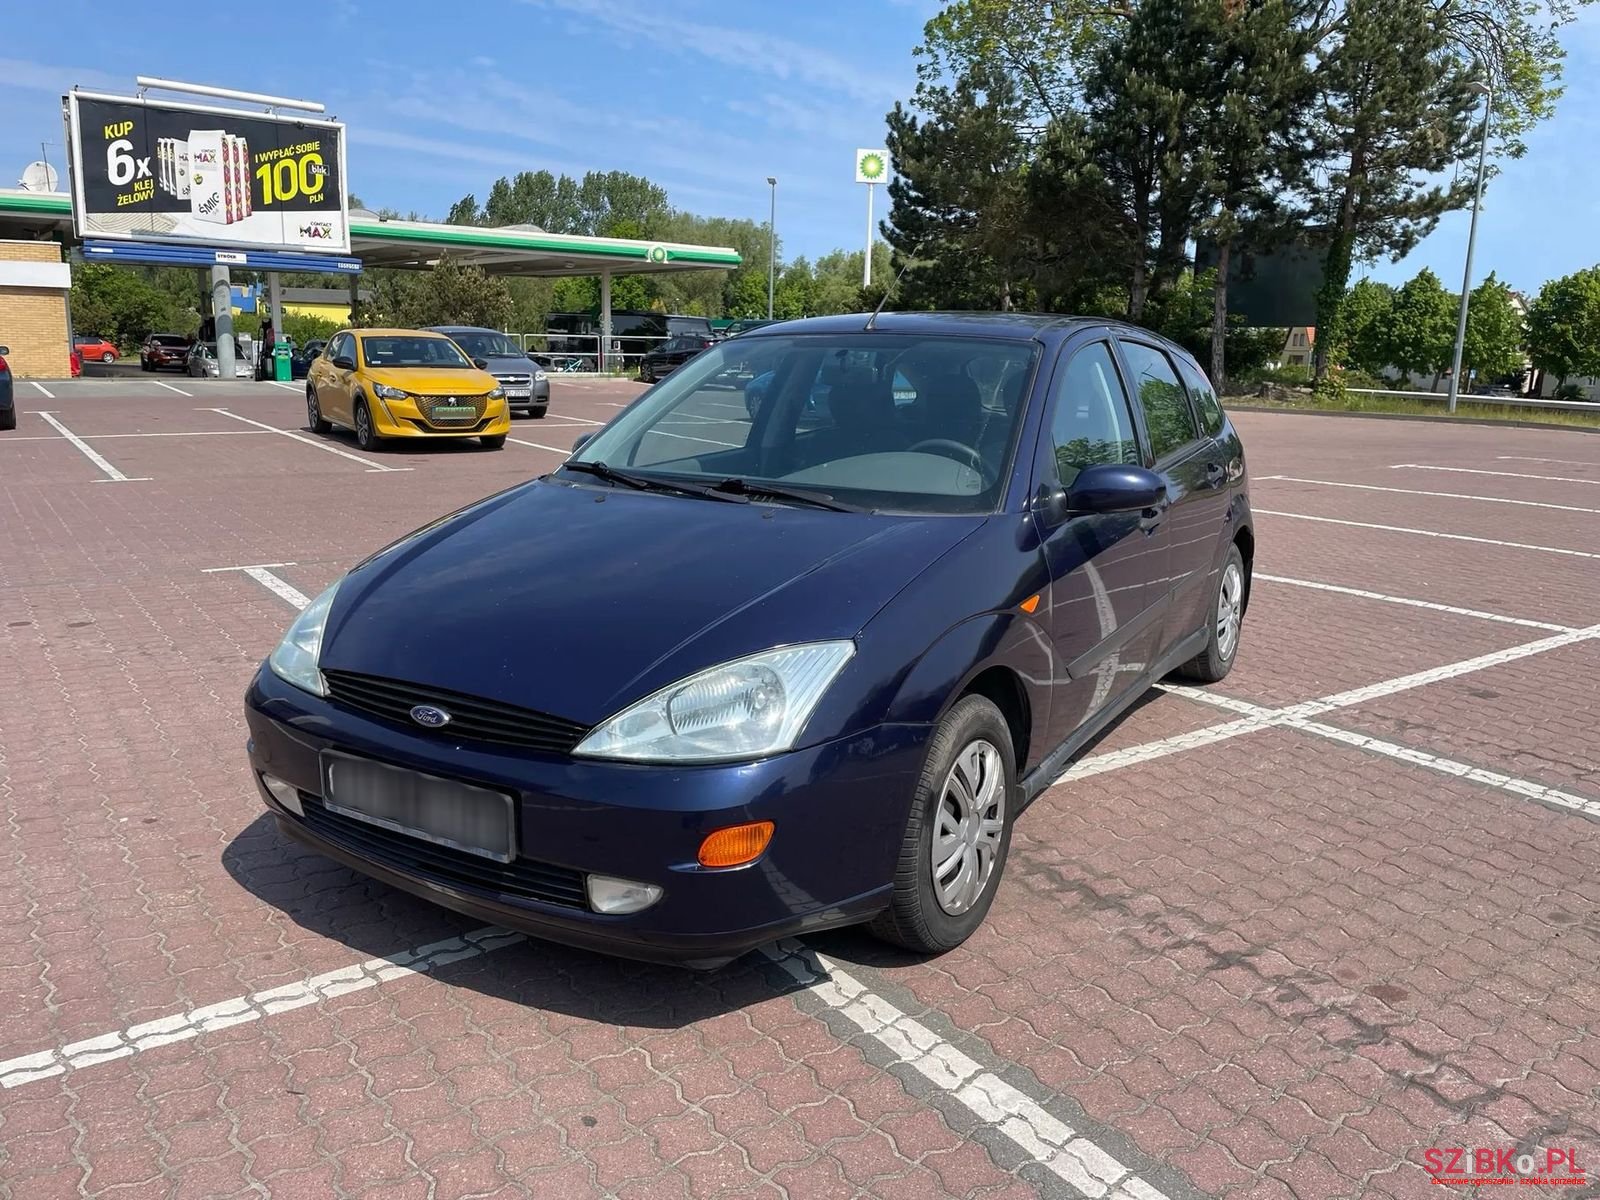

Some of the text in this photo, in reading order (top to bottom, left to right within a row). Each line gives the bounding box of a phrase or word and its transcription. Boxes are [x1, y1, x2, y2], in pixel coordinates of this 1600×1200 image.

[104, 121, 134, 139] KUP
[194, 153, 217, 163] MAX
[255, 141, 321, 163] I WYPŁAĆ SOBIE
[107, 139, 153, 186] 6x
[311, 164, 327, 174] blik
[134, 179, 154, 192] KLEJ
[256, 153, 324, 205] 100
[117, 189, 155, 206] ŻELOWY
[309, 193, 324, 204] PLN
[299, 226, 333, 239] MAX
[417, 709, 438, 724] Ford
